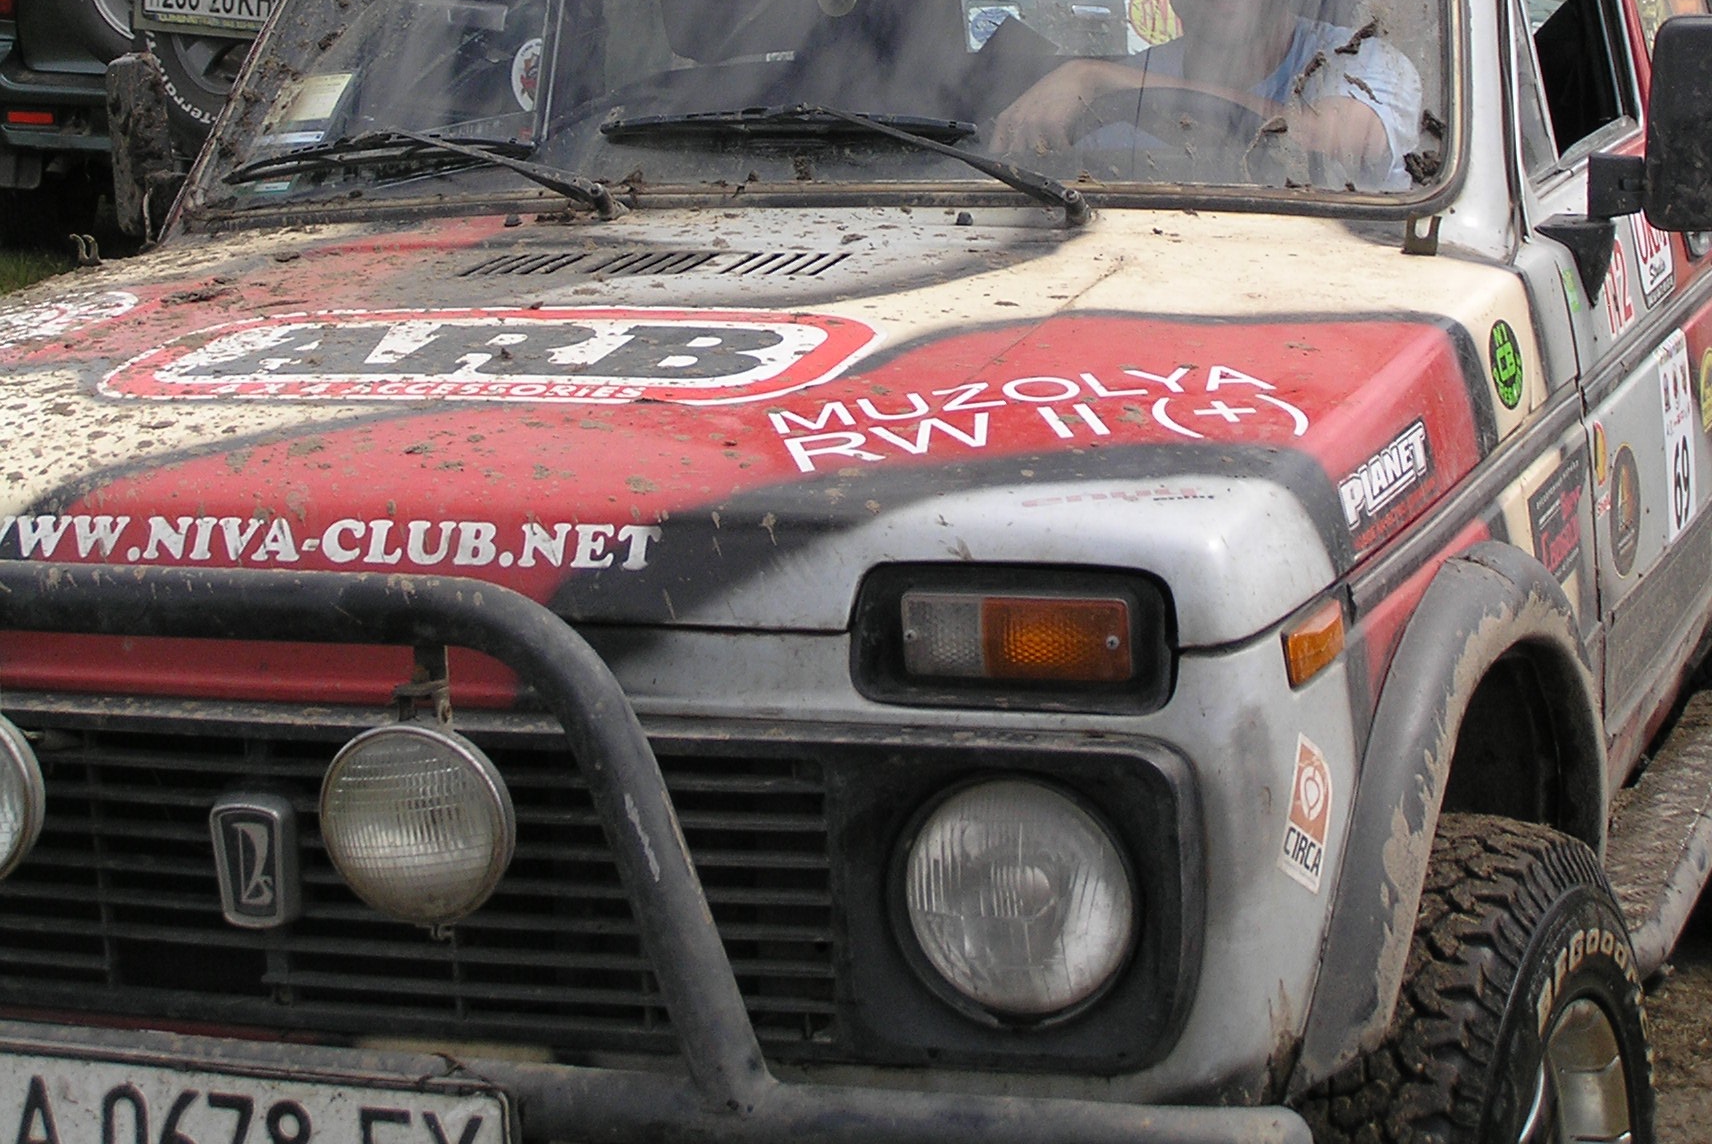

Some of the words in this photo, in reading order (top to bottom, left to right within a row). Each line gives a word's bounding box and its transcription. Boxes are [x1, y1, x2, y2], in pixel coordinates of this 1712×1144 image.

[185, 323, 784, 380] ARB
[341, 382, 647, 398] ACCESSORIES
[768, 365, 1276, 435] MUZOLYA
[783, 412, 990, 473] RW
[1152, 393, 1310, 439] (+)
[1338, 421, 1427, 531] PLANET
[1674, 435, 1690, 530] 69
[1283, 826, 1323, 877] CIRCA
